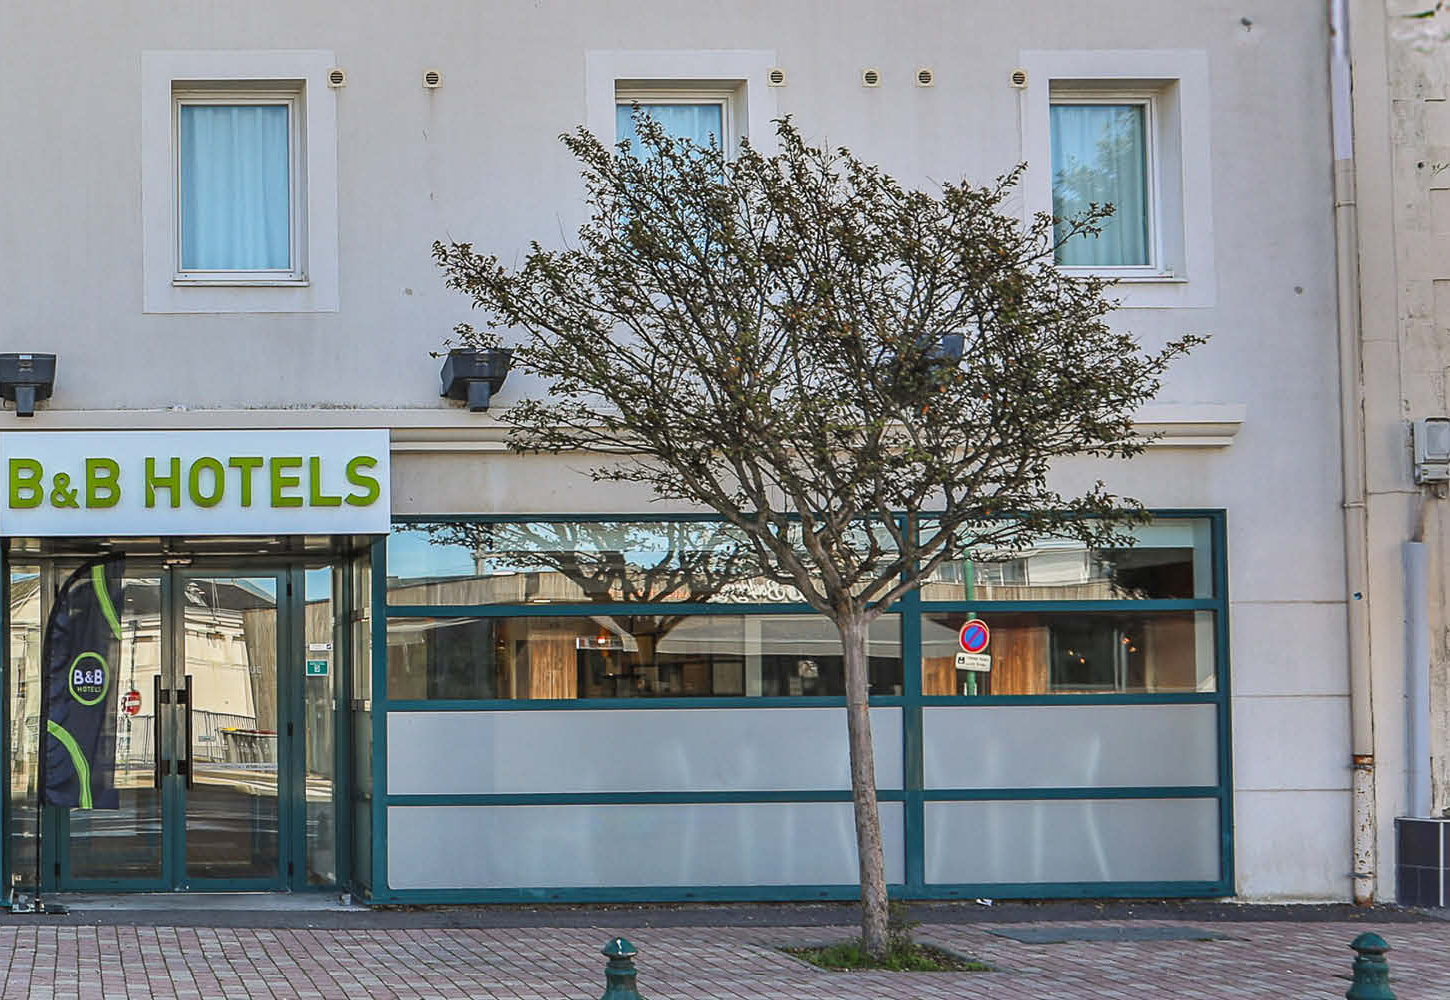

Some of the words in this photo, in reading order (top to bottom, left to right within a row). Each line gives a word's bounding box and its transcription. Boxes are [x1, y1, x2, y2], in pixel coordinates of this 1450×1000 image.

[8, 457, 121, 509] B&B
[144, 455, 381, 509] HOTELS
[73, 669, 103, 685] B&B
